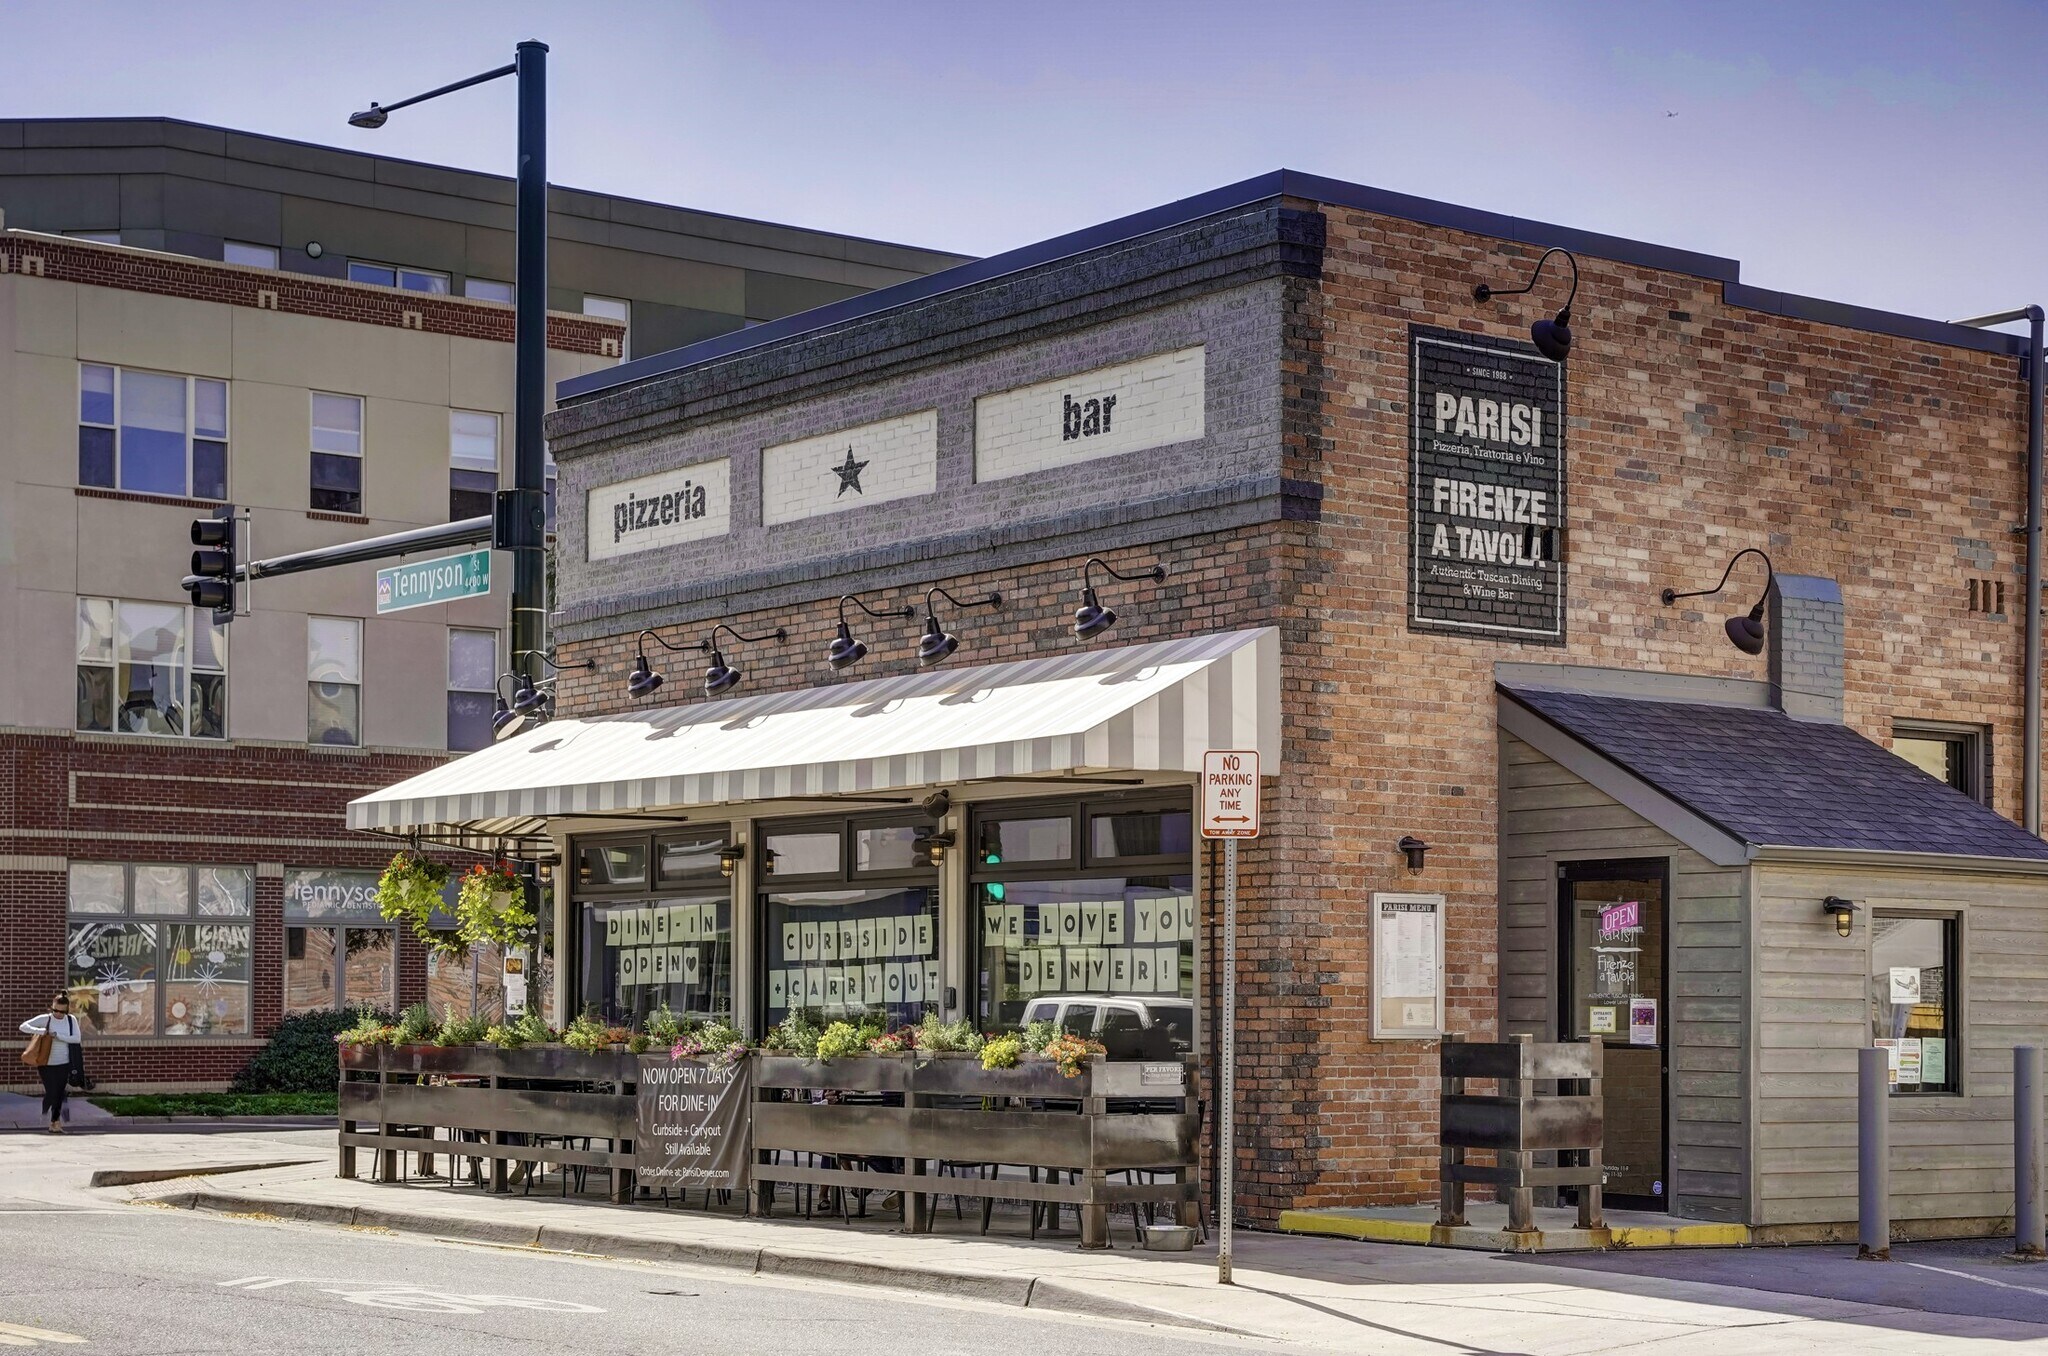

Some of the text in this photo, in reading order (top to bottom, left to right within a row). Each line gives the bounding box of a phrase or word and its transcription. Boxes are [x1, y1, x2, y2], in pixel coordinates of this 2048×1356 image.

[1472, 367, 1490, 378] SINCE
[1063, 394, 1117, 441] bar
[1435, 392, 1541, 447] PARISI
[1433, 440, 1545, 465] Pizzeria, Trattoria e Vino
[1433, 477, 1547, 526] FIRENZE
[614, 480, 706, 543] pizzeria
[1431, 523, 1451, 557] A
[473, 559, 480, 572] St
[393, 563, 463, 599] Tennyson
[482, 574, 489, 585] W
[1430, 564, 1543, 590] Authentic Tuscan Dining
[1463, 583, 1515, 600] & Wine Bar
[1222, 756, 1240, 771] NO
[1209, 773, 1253, 786] PARKING
[1219, 788, 1242, 798] ANY
[1219, 800, 1242, 810] TIME
[293, 880, 379, 908] tennyso
[1383, 903, 1432, 912] PARISI MENU
[610, 916, 713, 935] DINE-IN
[987, 908, 1193, 934] WE LOVE YOU
[1604, 904, 1636, 931] OPEN
[786, 926, 927, 950] CURBSIDE
[623, 955, 680, 974] OPEN
[1023, 960, 1168, 981] DENVER!
[1597, 955, 1635, 972] Firenze
[1599, 969, 1635, 985] a tavola
[642, 1066, 734, 1084] NOW OPEN 7 DAYS
[658, 1094, 719, 1112] FOR DINE-IN
[652, 1123, 682, 1136] Curbside
[690, 1124, 721, 1139] Carryout
[665, 1142, 711, 1156] Still Available
[656, 1166, 674, 1177] Online
